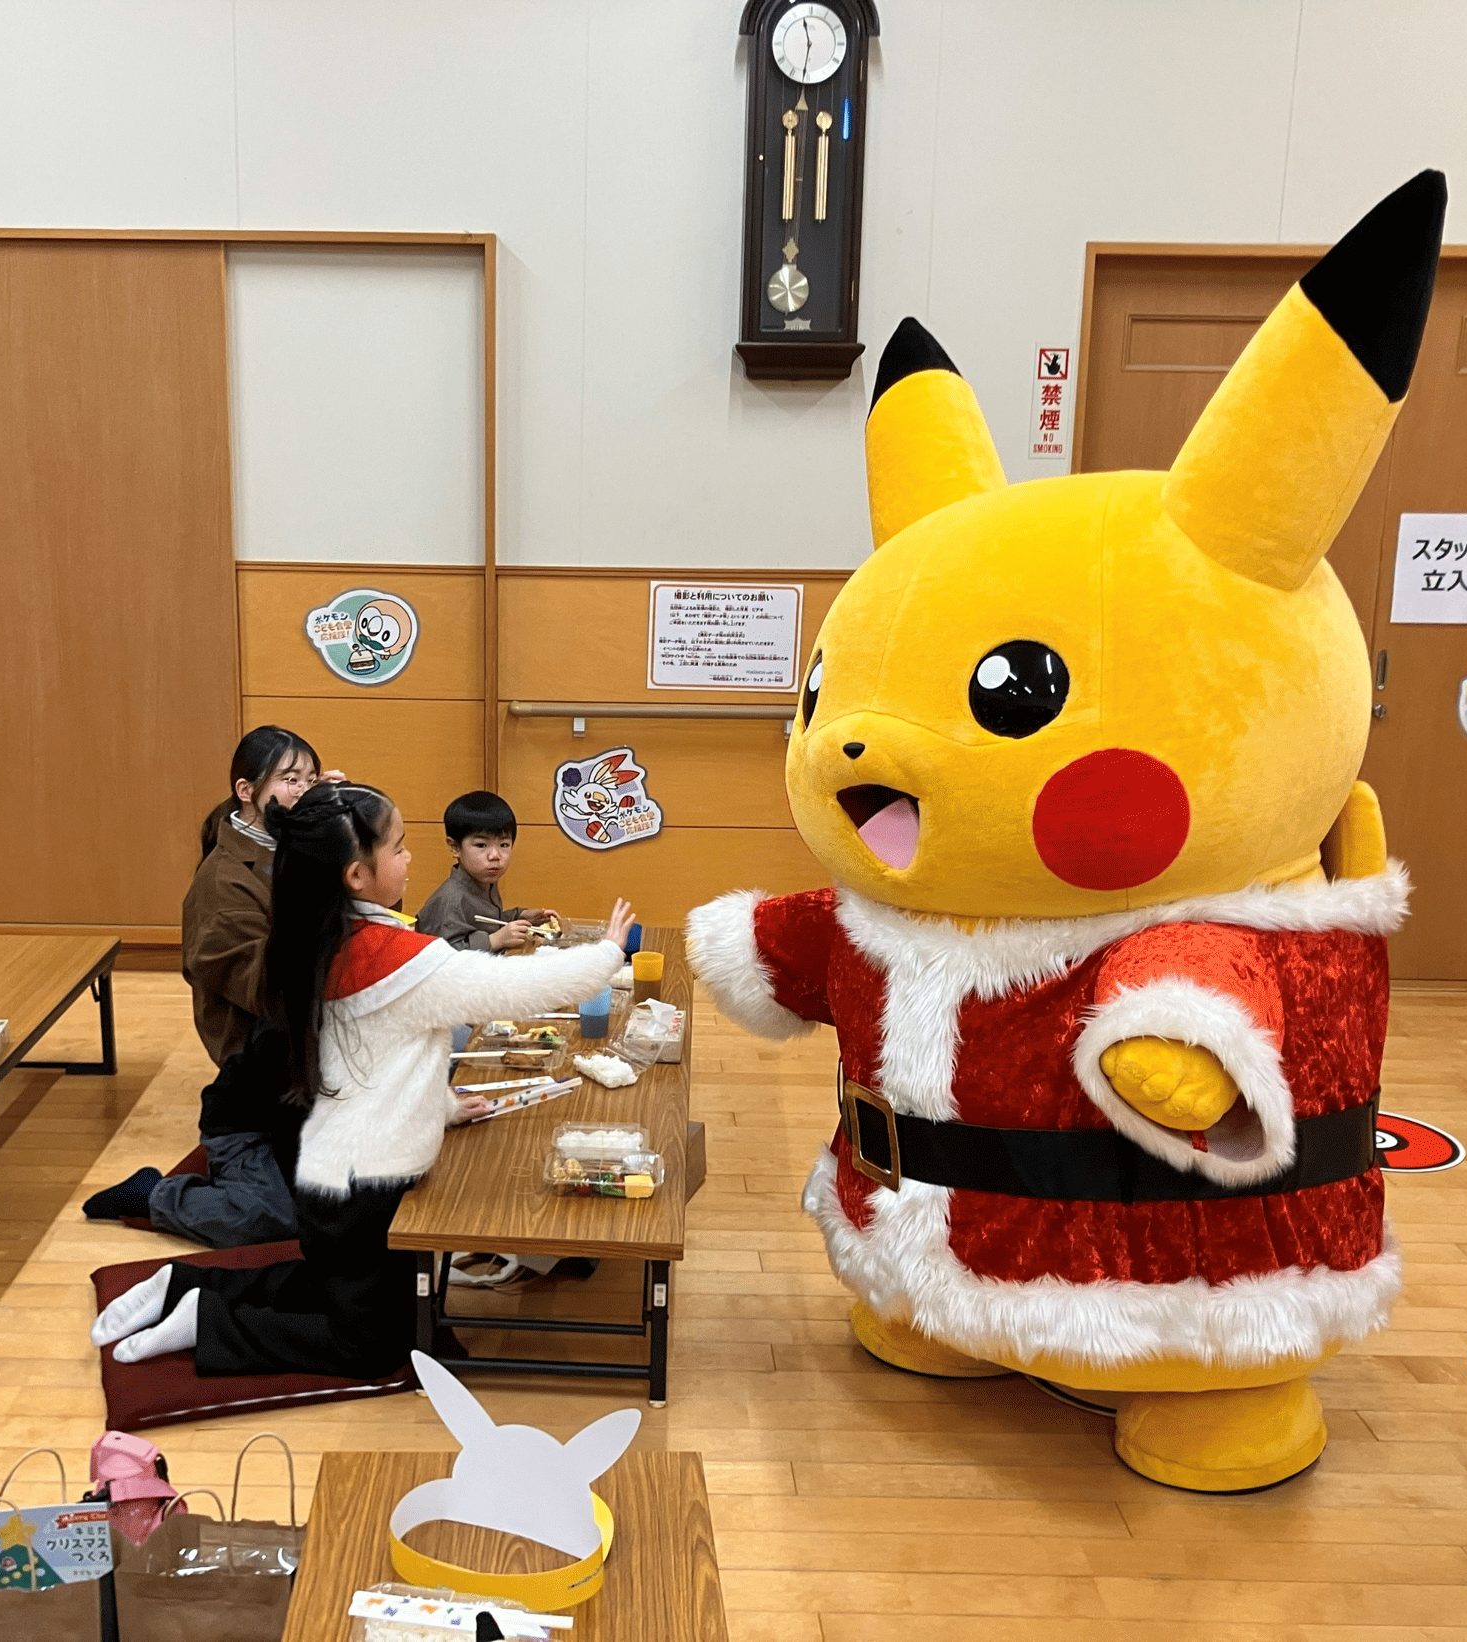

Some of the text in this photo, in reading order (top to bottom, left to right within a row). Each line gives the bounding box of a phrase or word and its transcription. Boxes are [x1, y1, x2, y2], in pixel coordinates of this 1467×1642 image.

[1039, 384, 1062, 430] 禁煙
[1043, 433, 1054, 442] NO
[1033, 444, 1063, 453] SMOKING
[315, 613, 348, 624] ポケモン
[47, 1537, 109, 1551] クリスマス
